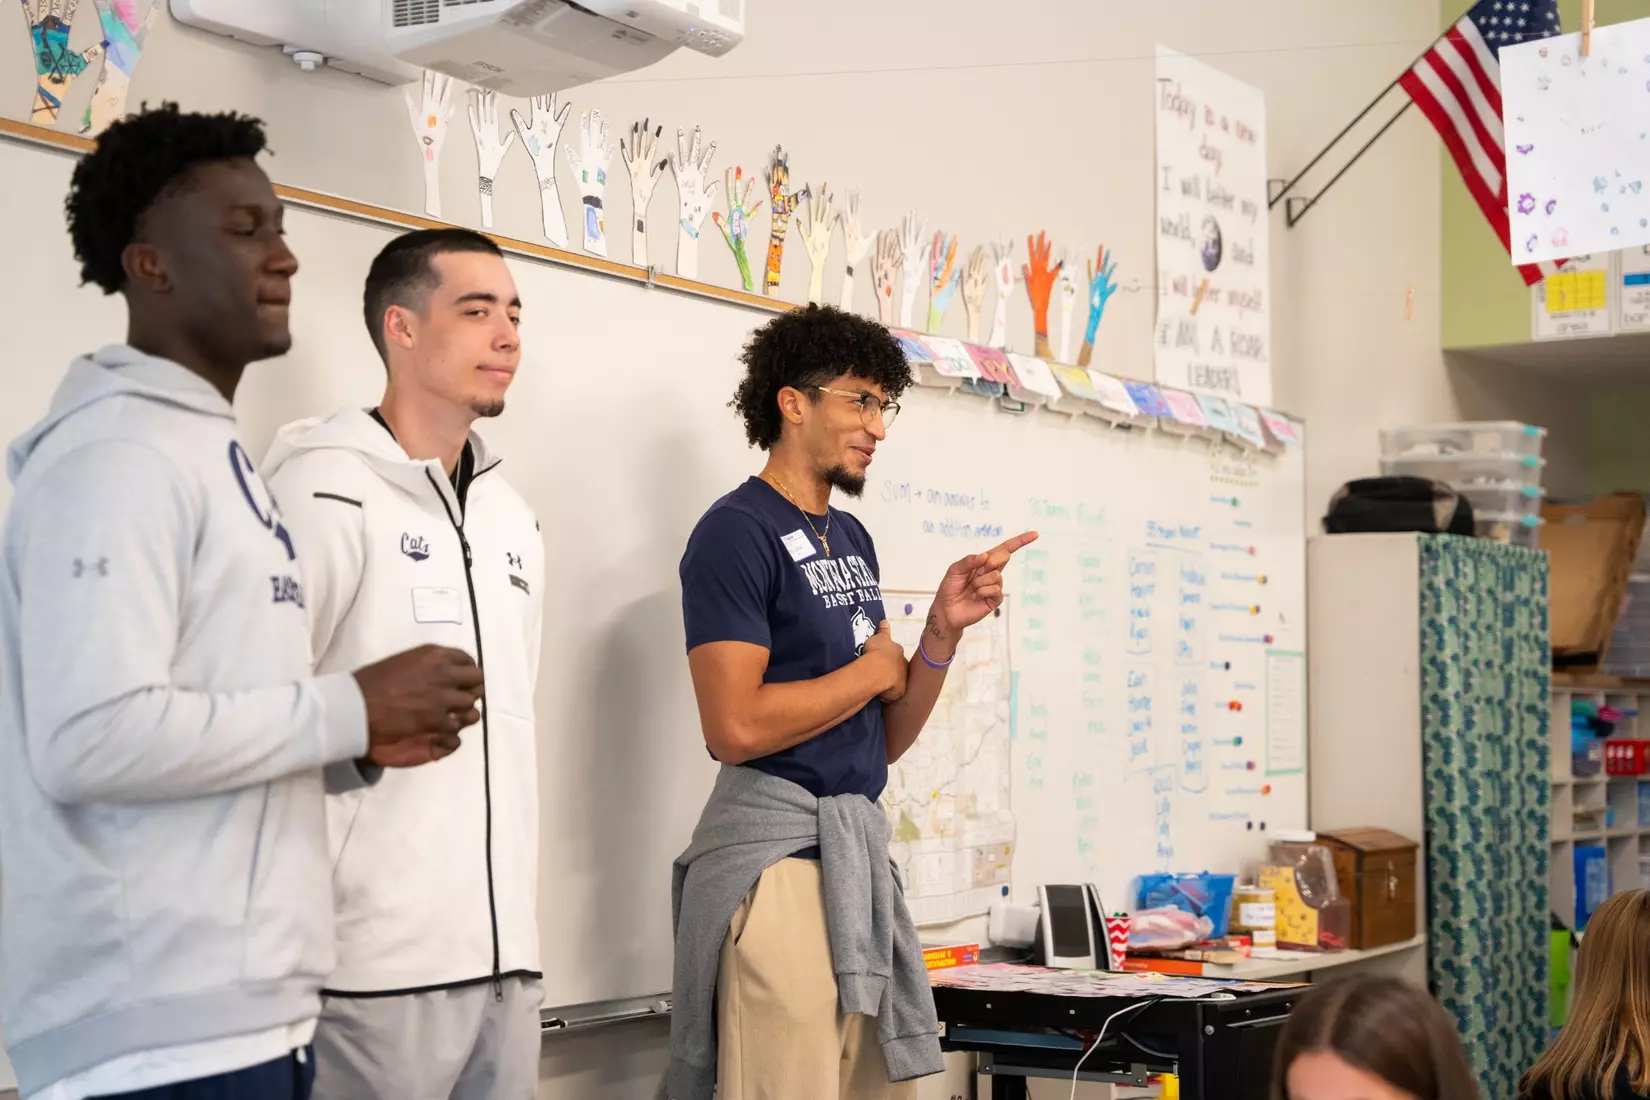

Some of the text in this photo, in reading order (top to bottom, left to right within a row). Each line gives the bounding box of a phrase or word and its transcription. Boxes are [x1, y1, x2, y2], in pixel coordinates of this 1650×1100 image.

[1157, 77, 1197, 131] Today
[1199, 134, 1222, 177] day
[400, 531, 429, 554] Cats
